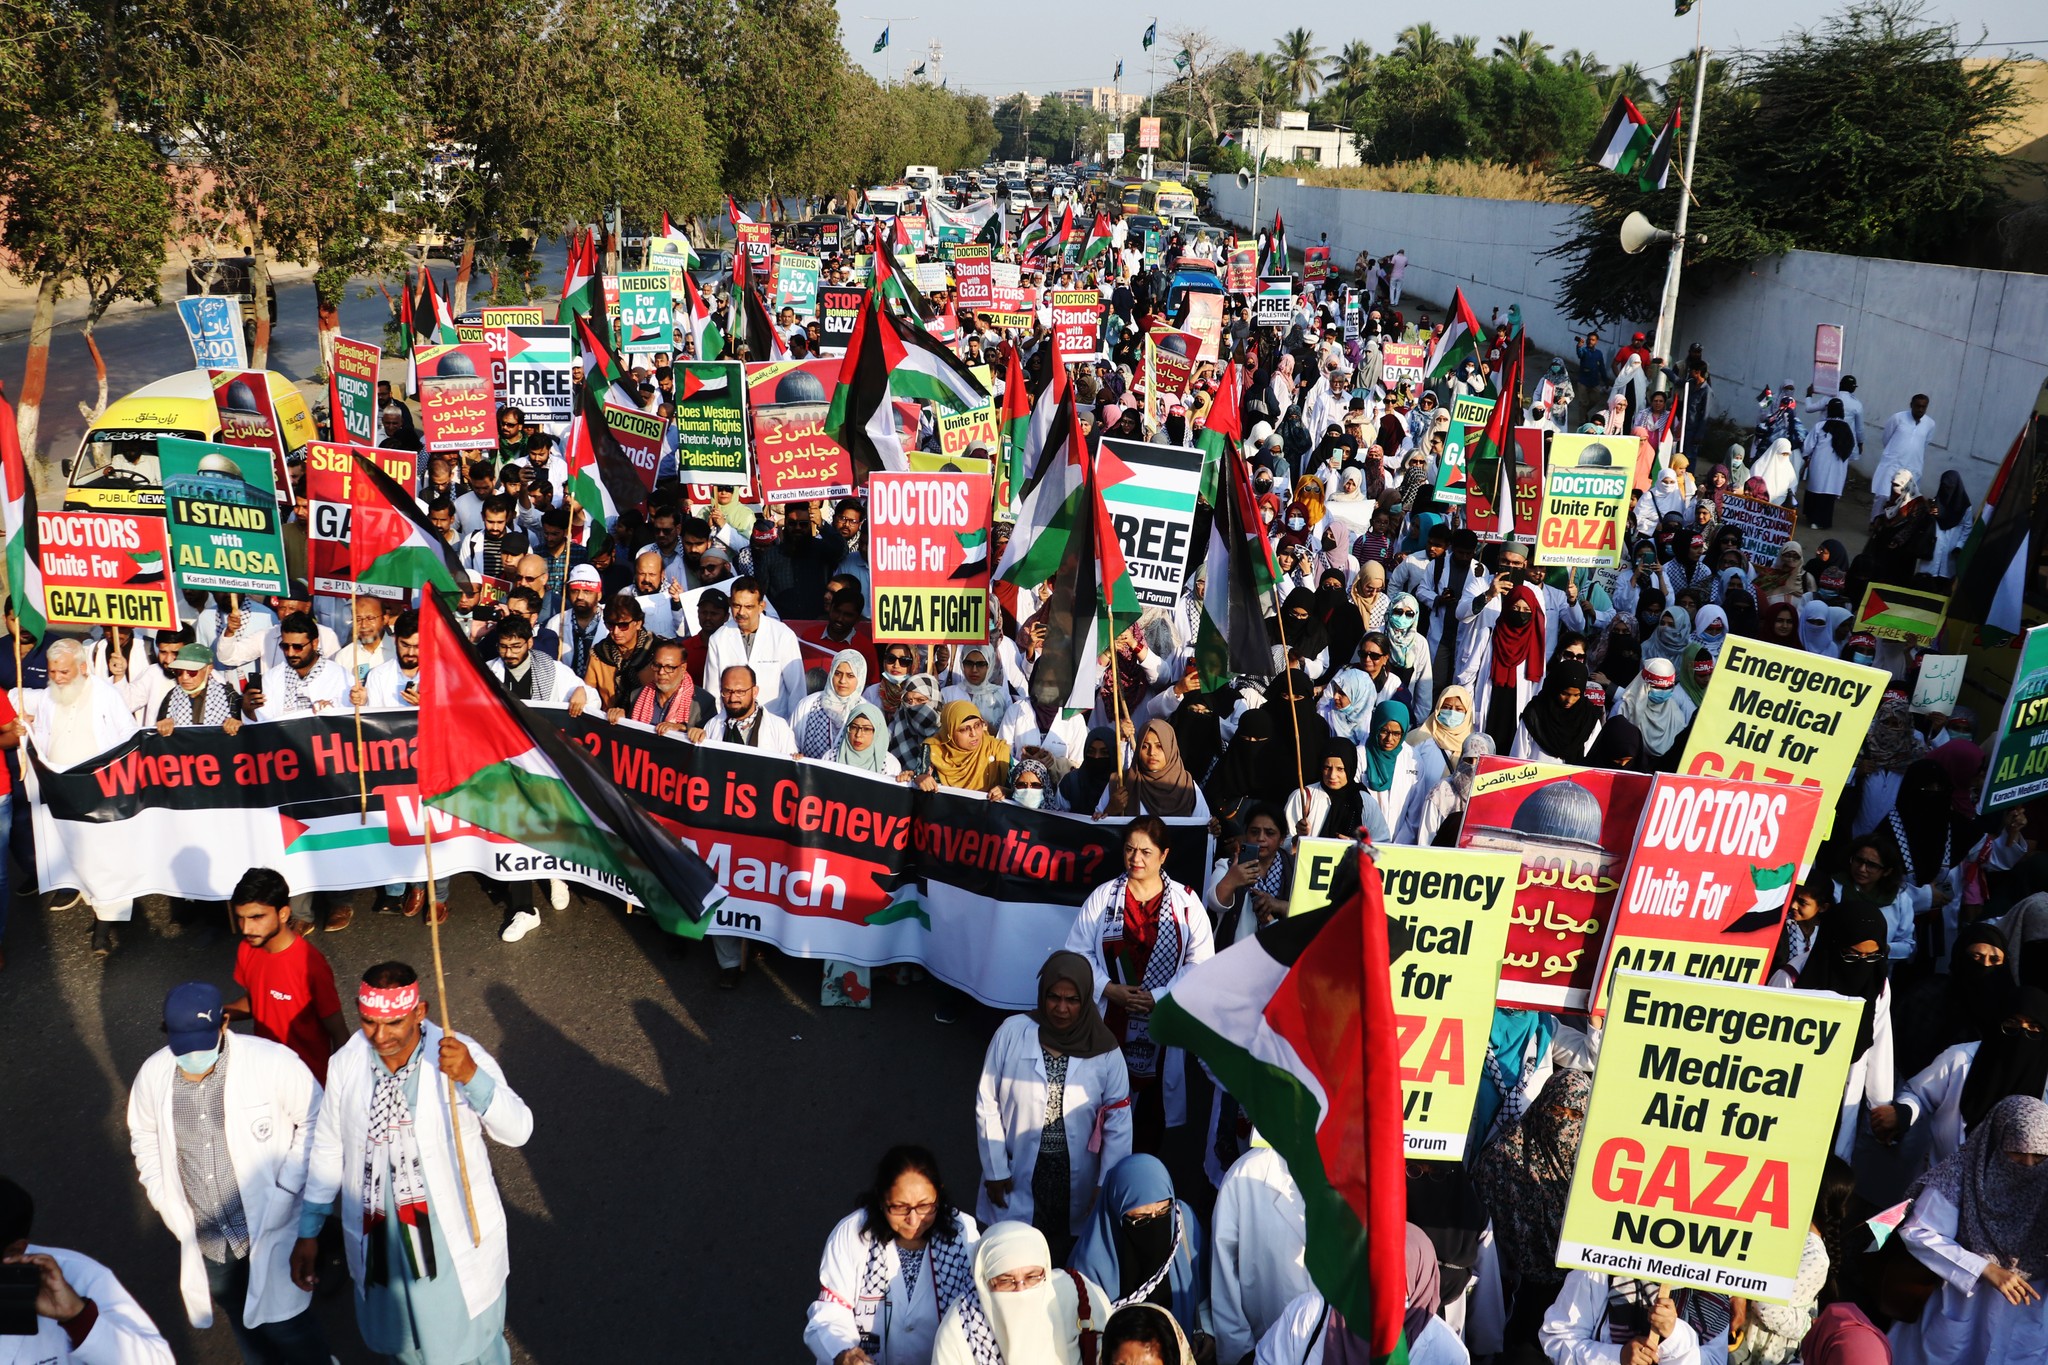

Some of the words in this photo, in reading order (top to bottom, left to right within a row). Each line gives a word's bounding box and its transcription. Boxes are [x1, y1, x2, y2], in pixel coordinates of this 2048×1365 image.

[739, 225, 758, 234] Stand
[760, 225, 769, 234] up
[822, 224, 838, 233] STOP
[748, 233, 759, 242] For
[822, 236, 838, 245] GAZA
[956, 246, 988, 257] DOCTORS
[652, 255, 684, 267] DOCTORS
[782, 257, 816, 269] MEDICS
[791, 269, 807, 280] For
[957, 263, 989, 277] Stands
[622, 277, 667, 291] MEDICS
[779, 279, 815, 295] GAZA
[959, 282, 989, 298] Gaza
[635, 293, 655, 306] For
[824, 293, 862, 309] STOP
[1000, 302, 1012, 310] For
[1055, 294, 1096, 304] DOCTORS
[1259, 299, 1290, 311] FREE
[487, 313, 540, 326] DOCTORS
[622, 306, 670, 325] GAZA
[826, 308, 858, 317] BOMBING
[1004, 315, 1030, 326] FIGHT
[1052, 309, 1097, 325] Stands
[1347, 313, 1358, 327] FREE
[824, 316, 856, 333] GAZ
[1066, 326, 1083, 335] with
[1058, 333, 1093, 350] Gaza
[1384, 344, 1409, 354] Stand
[1411, 346, 1422, 356] up
[334, 342, 363, 361] Palestine
[364, 347, 377, 364] Pain
[1396, 355, 1410, 365] For
[339, 359, 345, 368] is
[345, 360, 357, 372] Our
[357, 363, 371, 377] Pain
[338, 375, 368, 398] MEDICS
[509, 370, 571, 396] FREE
[509, 397, 571, 407] PALESTINE
[677, 405, 700, 418] Does
[703, 405, 741, 419] Western
[606, 409, 660, 438] DOCTORS
[678, 418, 710, 431] Human
[712, 418, 742, 433] Rights
[944, 414, 971, 431] Unite
[973, 411, 989, 422] For
[437, 424, 470, 439] سلام
[944, 423, 995, 454] GAZA
[433, 442, 453, 450] Karachi
[454, 441, 475, 449] Medical
[679, 434, 709, 445] Rhetoric
[711, 434, 732, 447] Apply
[734, 436, 742, 446] to
[681, 450, 742, 468] Palestine?
[384, 455, 412, 485] up
[776, 465, 818, 487] سلام
[771, 489, 796, 500] Karachi
[798, 487, 825, 498] Medical
[827, 487, 849, 495] Forum
[1550, 475, 1625, 497] DOCTORS
[98, 493, 137, 504] PUBLIC
[873, 480, 969, 526] DOCTORS
[179, 500, 188, 522] I
[192, 501, 266, 530] STAND
[1550, 499, 1589, 516] Unite
[1594, 502, 1618, 518] For
[38, 516, 140, 549] DOCTORS
[210, 533, 242, 548] with
[1517, 535, 1535, 543] Forum
[1541, 517, 1616, 550] GAZA
[179, 544, 209, 567] AL
[214, 547, 281, 575] AQSA
[876, 537, 916, 571] Unite
[922, 538, 945, 571] For
[1542, 555, 1566, 564] Karachi
[1566, 556, 1591, 564] Medical
[1592, 557, 1611, 565] Forum
[1754, 554, 1775, 567] NOW
[43, 552, 88, 578] Unite
[92, 555, 118, 579] For
[186, 575, 216, 585] Karachi
[219, 577, 250, 588] Medical
[252, 580, 277, 590] Forum
[368, 586, 396, 597] Karachi
[1146, 591, 1172, 604] Forum
[51, 590, 101, 617] GAZA
[107, 594, 164, 622] FIGHT
[879, 593, 924, 632] GAZA
[930, 594, 983, 633] FIGHT
[1877, 627, 1900, 638] FREE
[1725, 645, 1872, 708] Emergency
[1728, 686, 1842, 736] Medical
[1725, 721, 1774, 754] Aid
[1781, 734, 1820, 765] for
[94, 750, 221, 798] Where
[234, 749, 299, 786] are
[1995, 754, 2019, 784] AL
[612, 740, 710, 812] Where
[724, 772, 758, 819] is
[773, 779, 909, 852] Geneva
[1993, 787, 2017, 802] Karachi
[2018, 782, 2041, 796] Medical
[1643, 785, 1787, 859] DOCTORS
[1516, 858, 1620, 894] حماس
[1628, 866, 1690, 917] Unite
[1689, 871, 1732, 921] For
[1401, 963, 1452, 1000] for
[1624, 988, 1841, 1055] Emergency
[1638, 1043, 1804, 1099] Medical
[1641, 1092, 1710, 1132] Aid
[1720, 1102, 1779, 1142] for
[1403, 1134, 1447, 1151] Forum
[1591, 1136, 1790, 1230] GAZA
[1611, 1210, 1753, 1262] NOW!
[1581, 1247, 1642, 1270] Karachi
[1647, 1258, 1711, 1283] Medical
[1715, 1270, 1767, 1292] Forum
